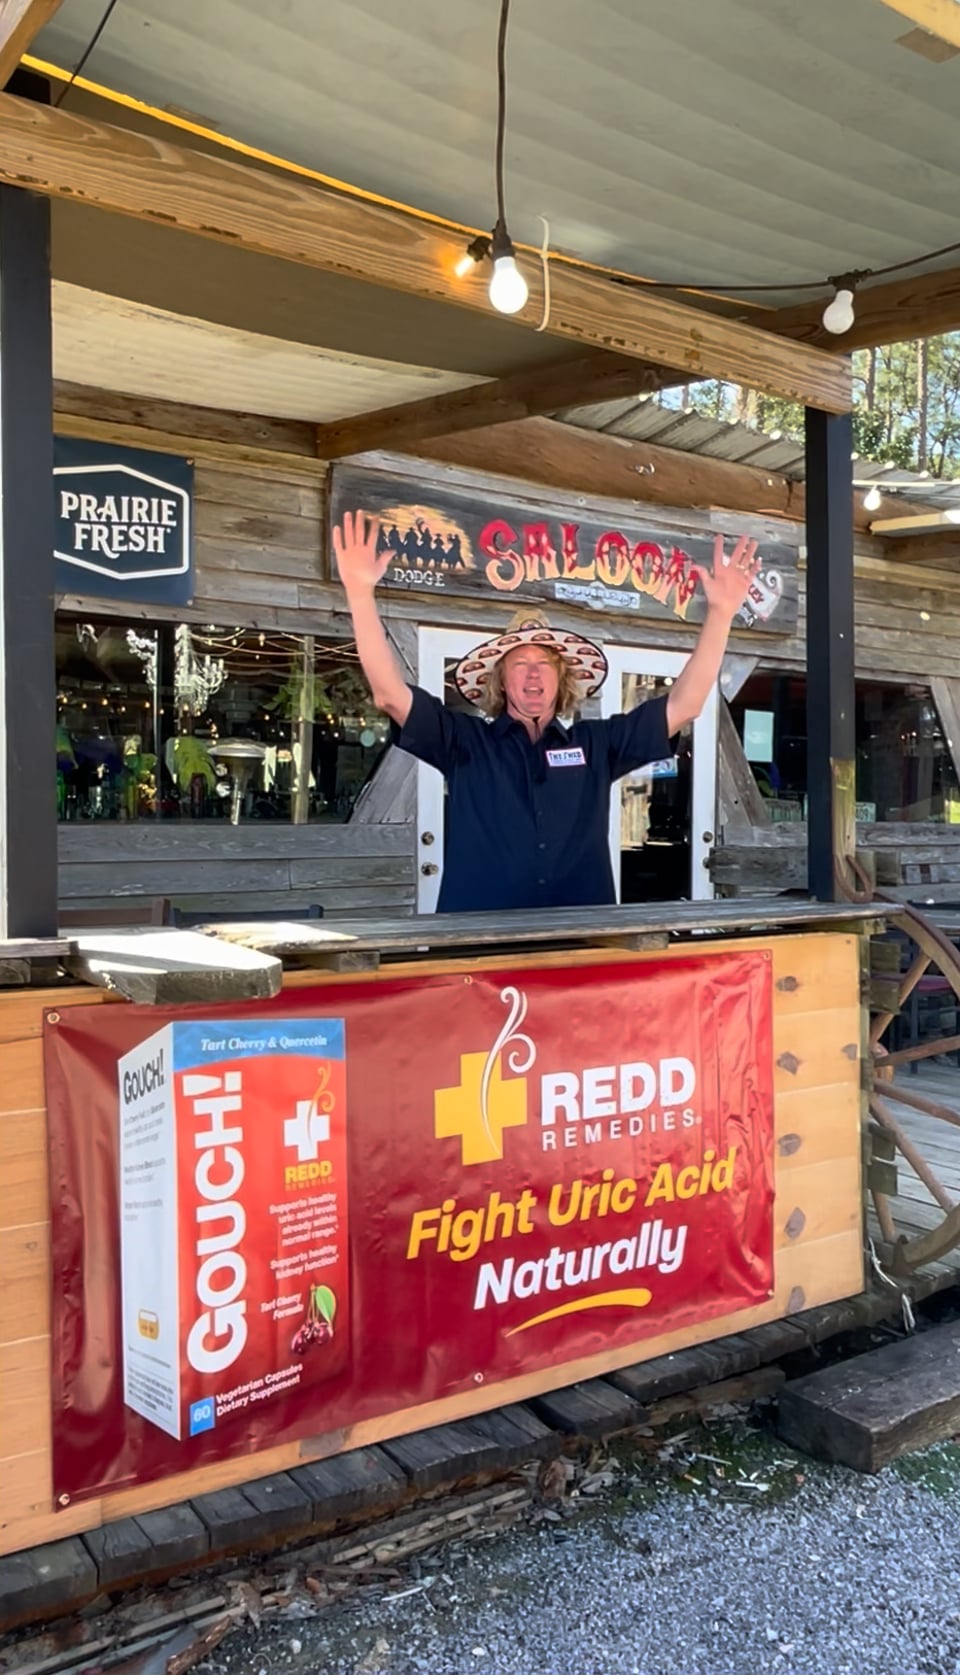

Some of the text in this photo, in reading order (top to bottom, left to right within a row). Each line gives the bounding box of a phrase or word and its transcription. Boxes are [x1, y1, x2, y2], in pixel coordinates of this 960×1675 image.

[60, 490, 177, 527] PRAIRIE
[74, 522, 167, 559] FRESH
[393, 567, 445, 587] DODGE
[479, 519, 700, 621] SALOON
[201, 1034, 328, 1051] Tart Cherry & Quercetin
[123, 1048, 165, 1105] GOUCH!
[541, 1056, 697, 1127] REDD
[542, 1108, 696, 1152] REMEDIES
[284, 1160, 333, 1184] REDD
[269, 1192, 337, 1215] Supports healthy
[296, 1207, 314, 1219] acid
[314, 1203, 337, 1215] levels
[406, 1145, 738, 1262] Fight Uric Acid
[182, 1071, 248, 1374] GOUCH!
[281, 1231, 312, 1247] normal
[282, 1215, 338, 1235] already within
[270, 1244, 338, 1270] Supports healthy
[275, 1265, 304, 1280] kidney
[473, 1219, 689, 1311] Naturally
[216, 1363, 304, 1404] Vegetarian Capsules
[216, 1374, 301, 1417] Dietary Supplement
[193, 1405, 211, 1423] 60
